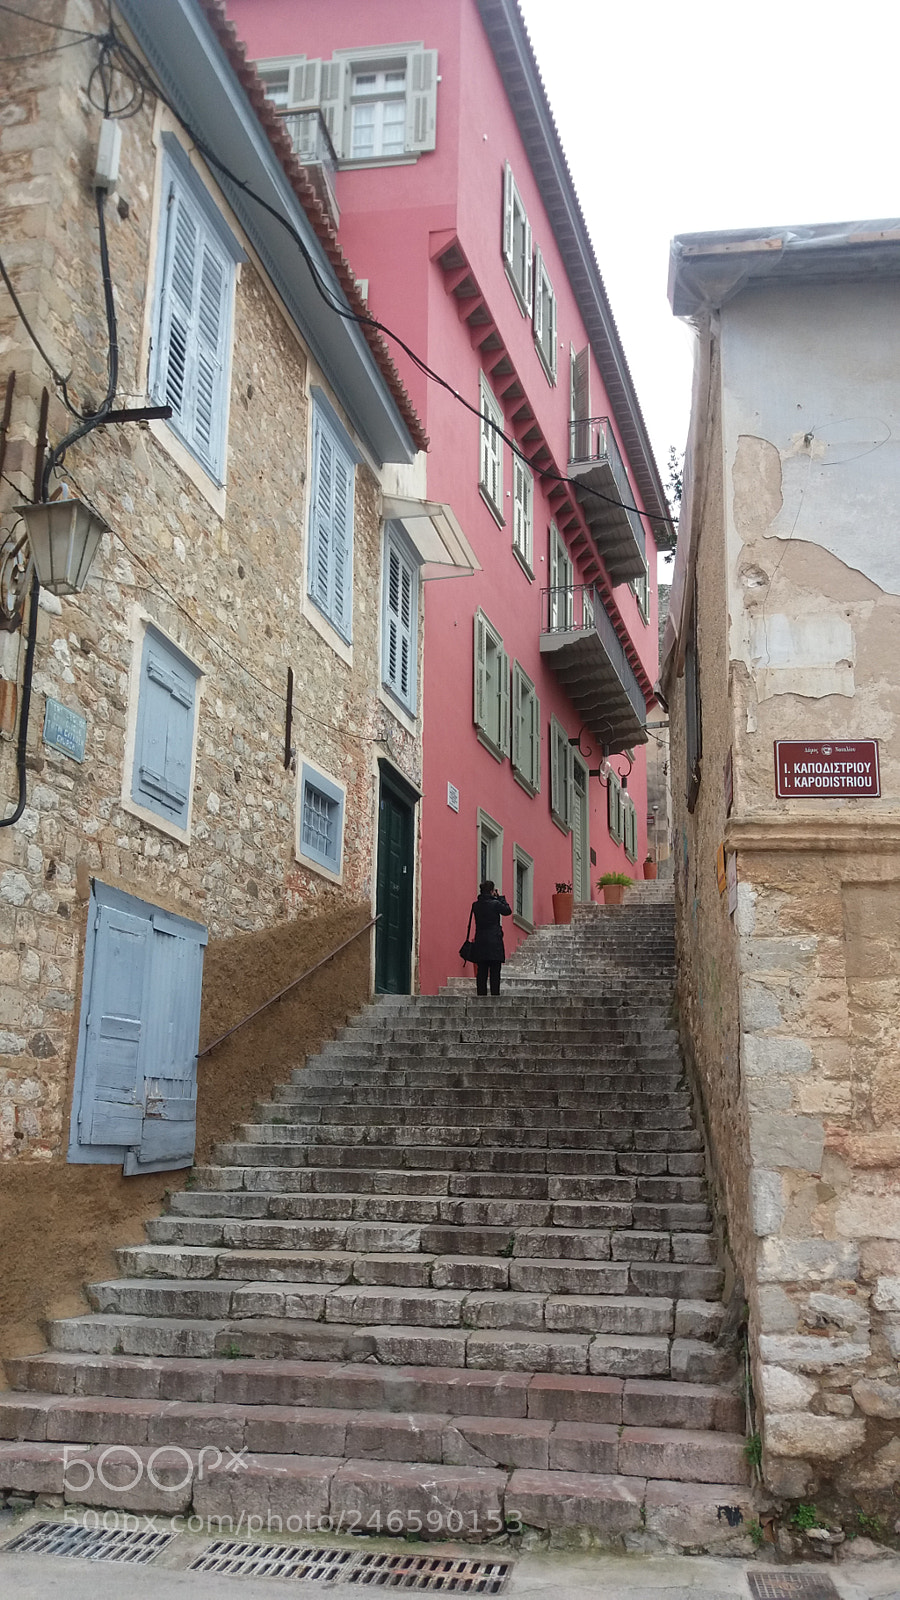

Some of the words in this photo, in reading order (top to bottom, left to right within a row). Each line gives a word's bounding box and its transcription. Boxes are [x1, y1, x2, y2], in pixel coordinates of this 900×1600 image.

[794, 762, 871, 774] ΚΑΠΟΔΙΣΤΡΙΟΥ
[784, 776, 791, 788] I.
[794, 776, 872, 788] KAPODISTRIOU
